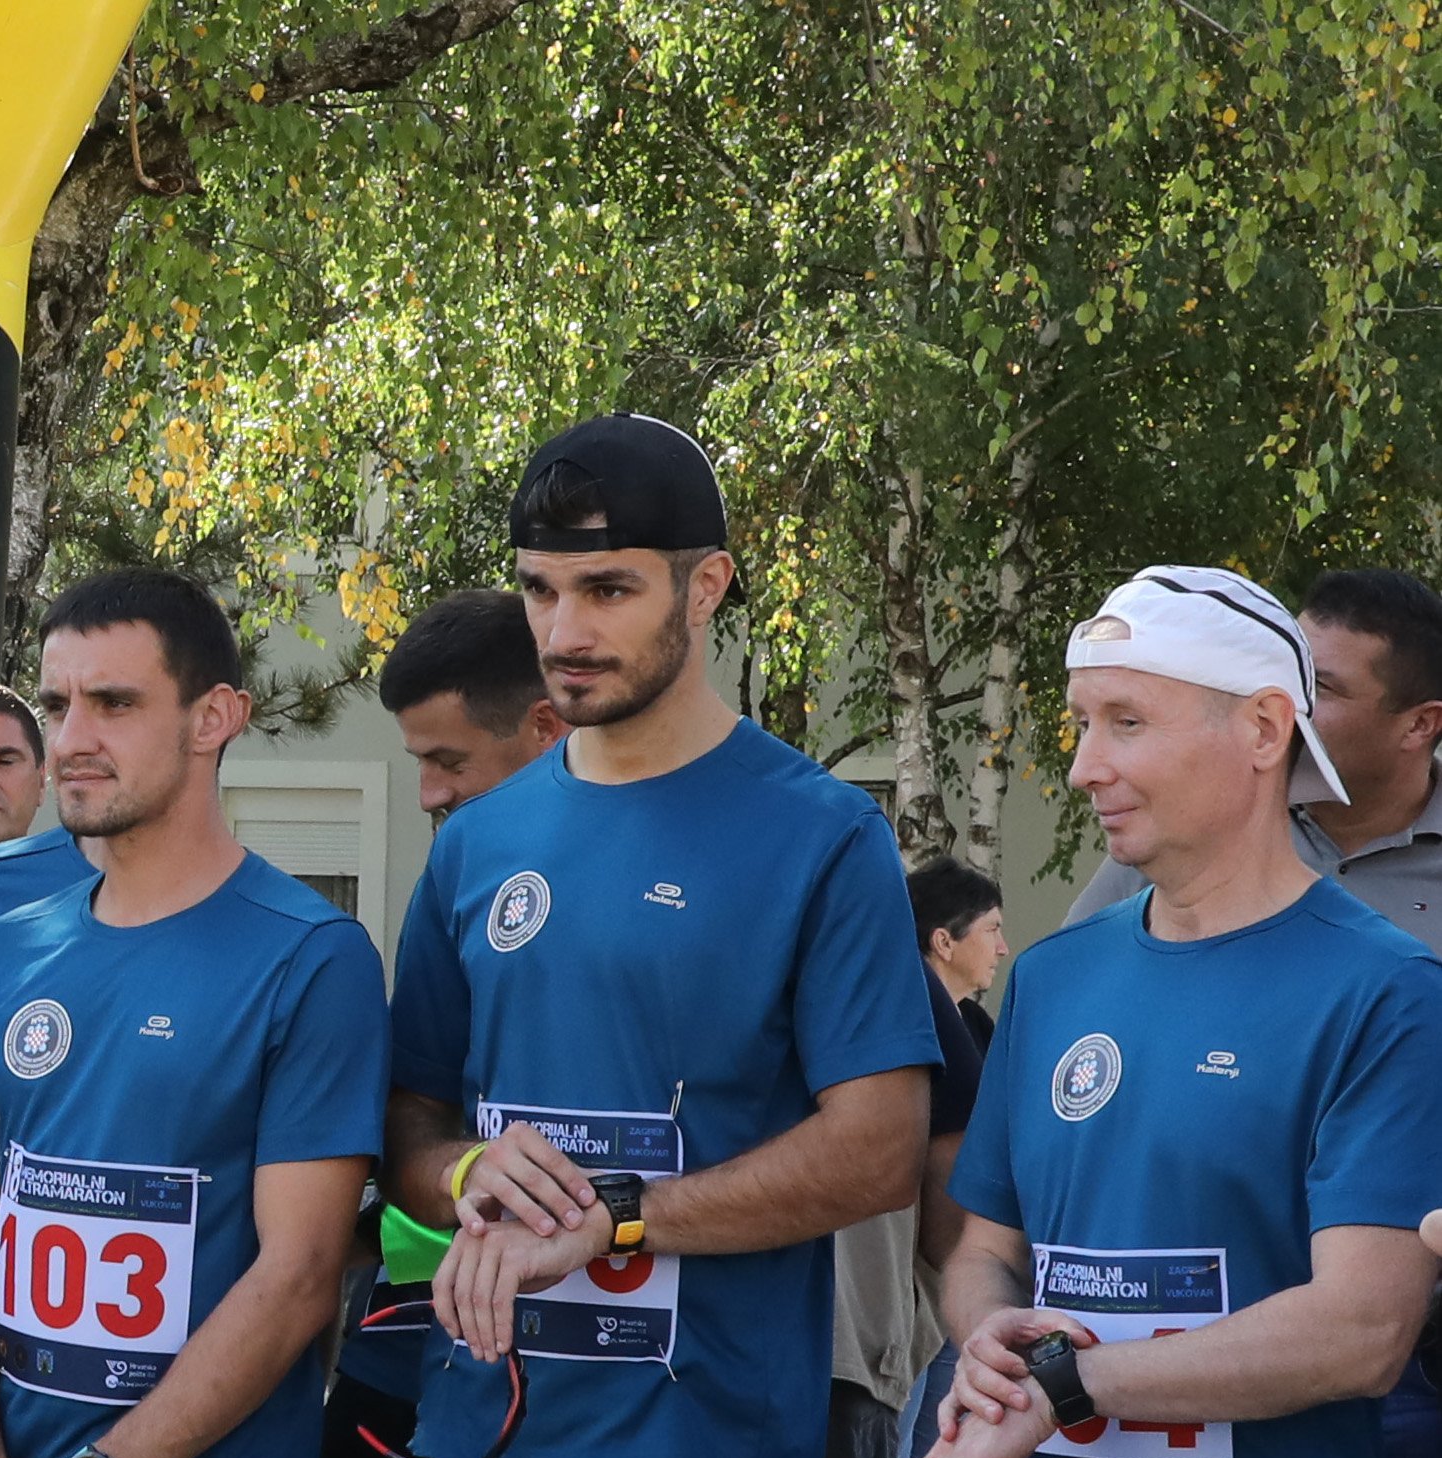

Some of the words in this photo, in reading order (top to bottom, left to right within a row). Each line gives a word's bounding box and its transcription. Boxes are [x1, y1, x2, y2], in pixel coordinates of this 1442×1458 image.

[1196, 1063, 1240, 1080] Kalenji
[0, 1213, 168, 1339] 103
[1050, 1261, 1123, 1283] MEMORIJALNI
[1048, 1276, 1148, 1299] ULTRAMARATON
